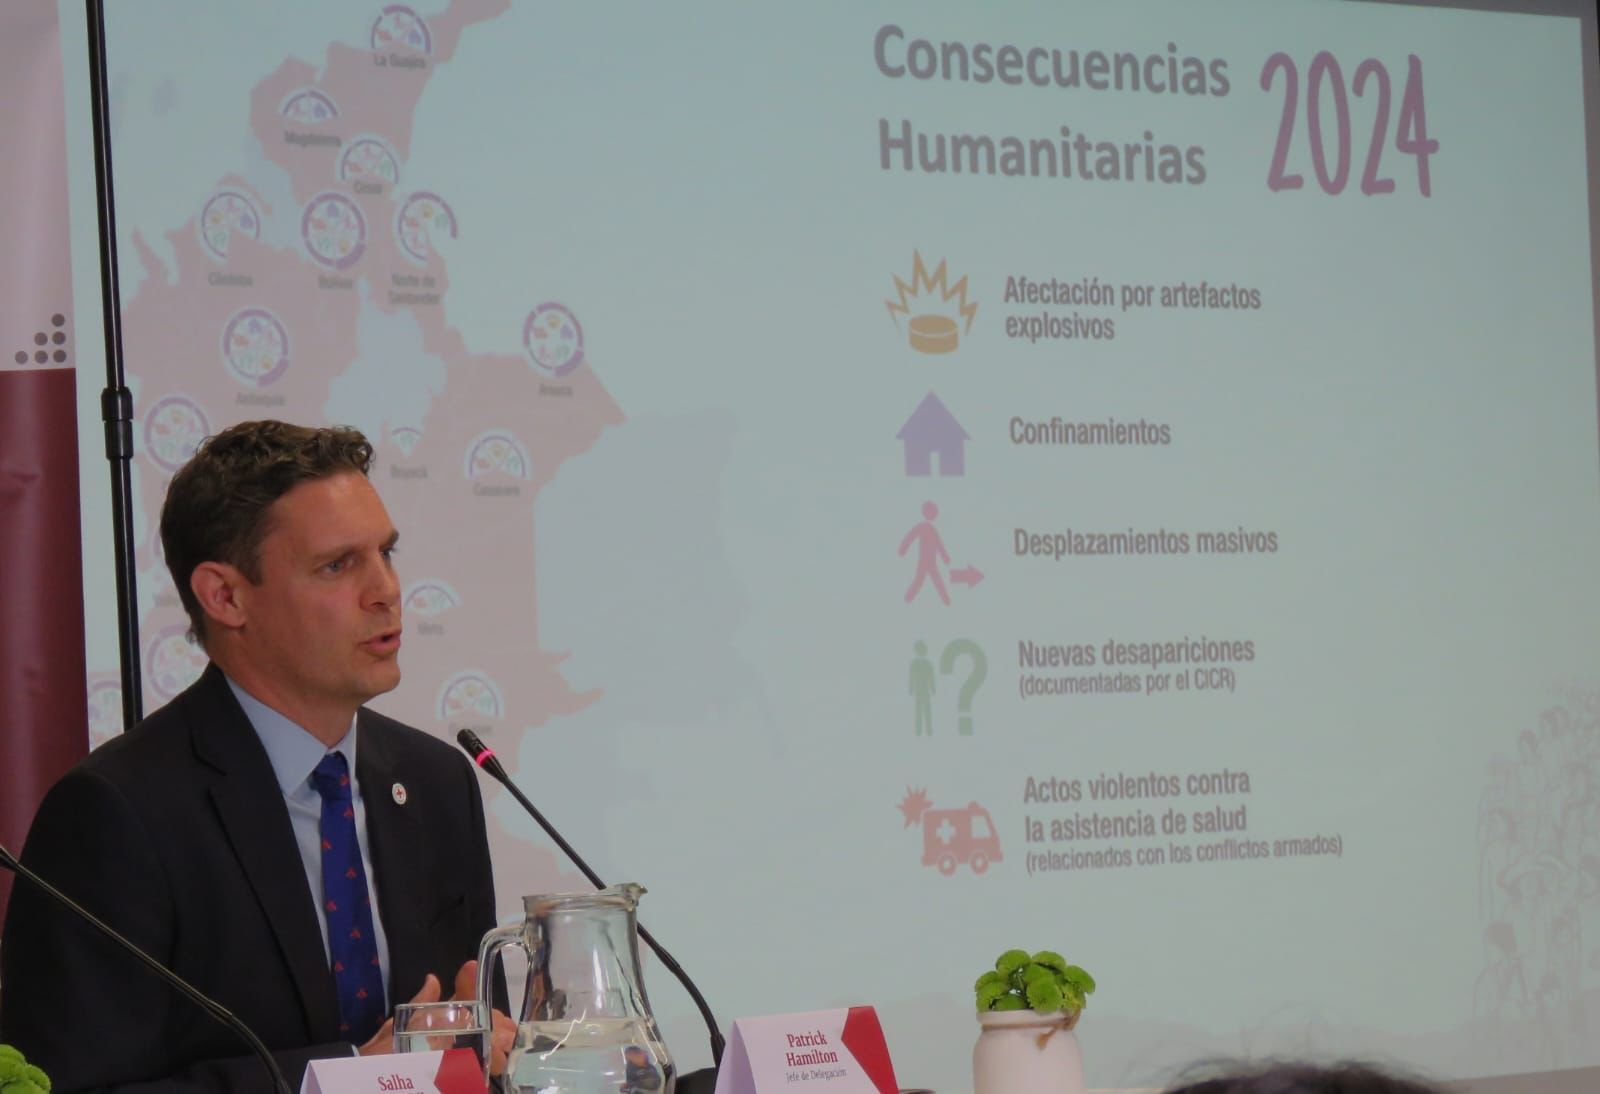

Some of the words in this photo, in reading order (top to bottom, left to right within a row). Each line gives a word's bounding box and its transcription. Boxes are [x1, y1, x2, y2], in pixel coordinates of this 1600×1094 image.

[873, 24, 1230, 97] Consecuencias
[1259, 51, 1440, 198] 2024
[878, 117, 1207, 185] Humanitarias
[1004, 275, 1114, 306] Afectación
[1121, 283, 1155, 312] por
[1160, 281, 1262, 310] artefactos
[1005, 312, 1115, 344] explosivos
[1009, 416, 1172, 446] Confinamientos
[1013, 527, 1190, 561] Desplazamientos
[1196, 526, 1279, 554] masivos
[1018, 639, 1096, 668] Nuevas
[1101, 635, 1256, 671] desapariciones
[1019, 672, 1142, 699] (documentadas
[1146, 674, 1171, 696] por
[1176, 670, 1190, 690] el
[1194, 667, 1236, 692] CICR)
[1023, 776, 1082, 803] Actos
[1088, 771, 1181, 801] violentos
[1186, 768, 1251, 797] contra
[1025, 816, 1044, 842] la
[1050, 809, 1156, 841] asistencia
[1161, 807, 1187, 835] de
[1192, 804, 1248, 832] salud
[1026, 846, 1133, 877] (relacionados
[1136, 847, 1166, 867] con
[1169, 842, 1193, 864] los
[1196, 838, 1270, 861] conflictos
[1273, 833, 1343, 858] armados)
[786, 1030, 828, 1048] Patrick
[785, 1049, 839, 1067] Hamilton
[377, 1074, 414, 1091] Salha
